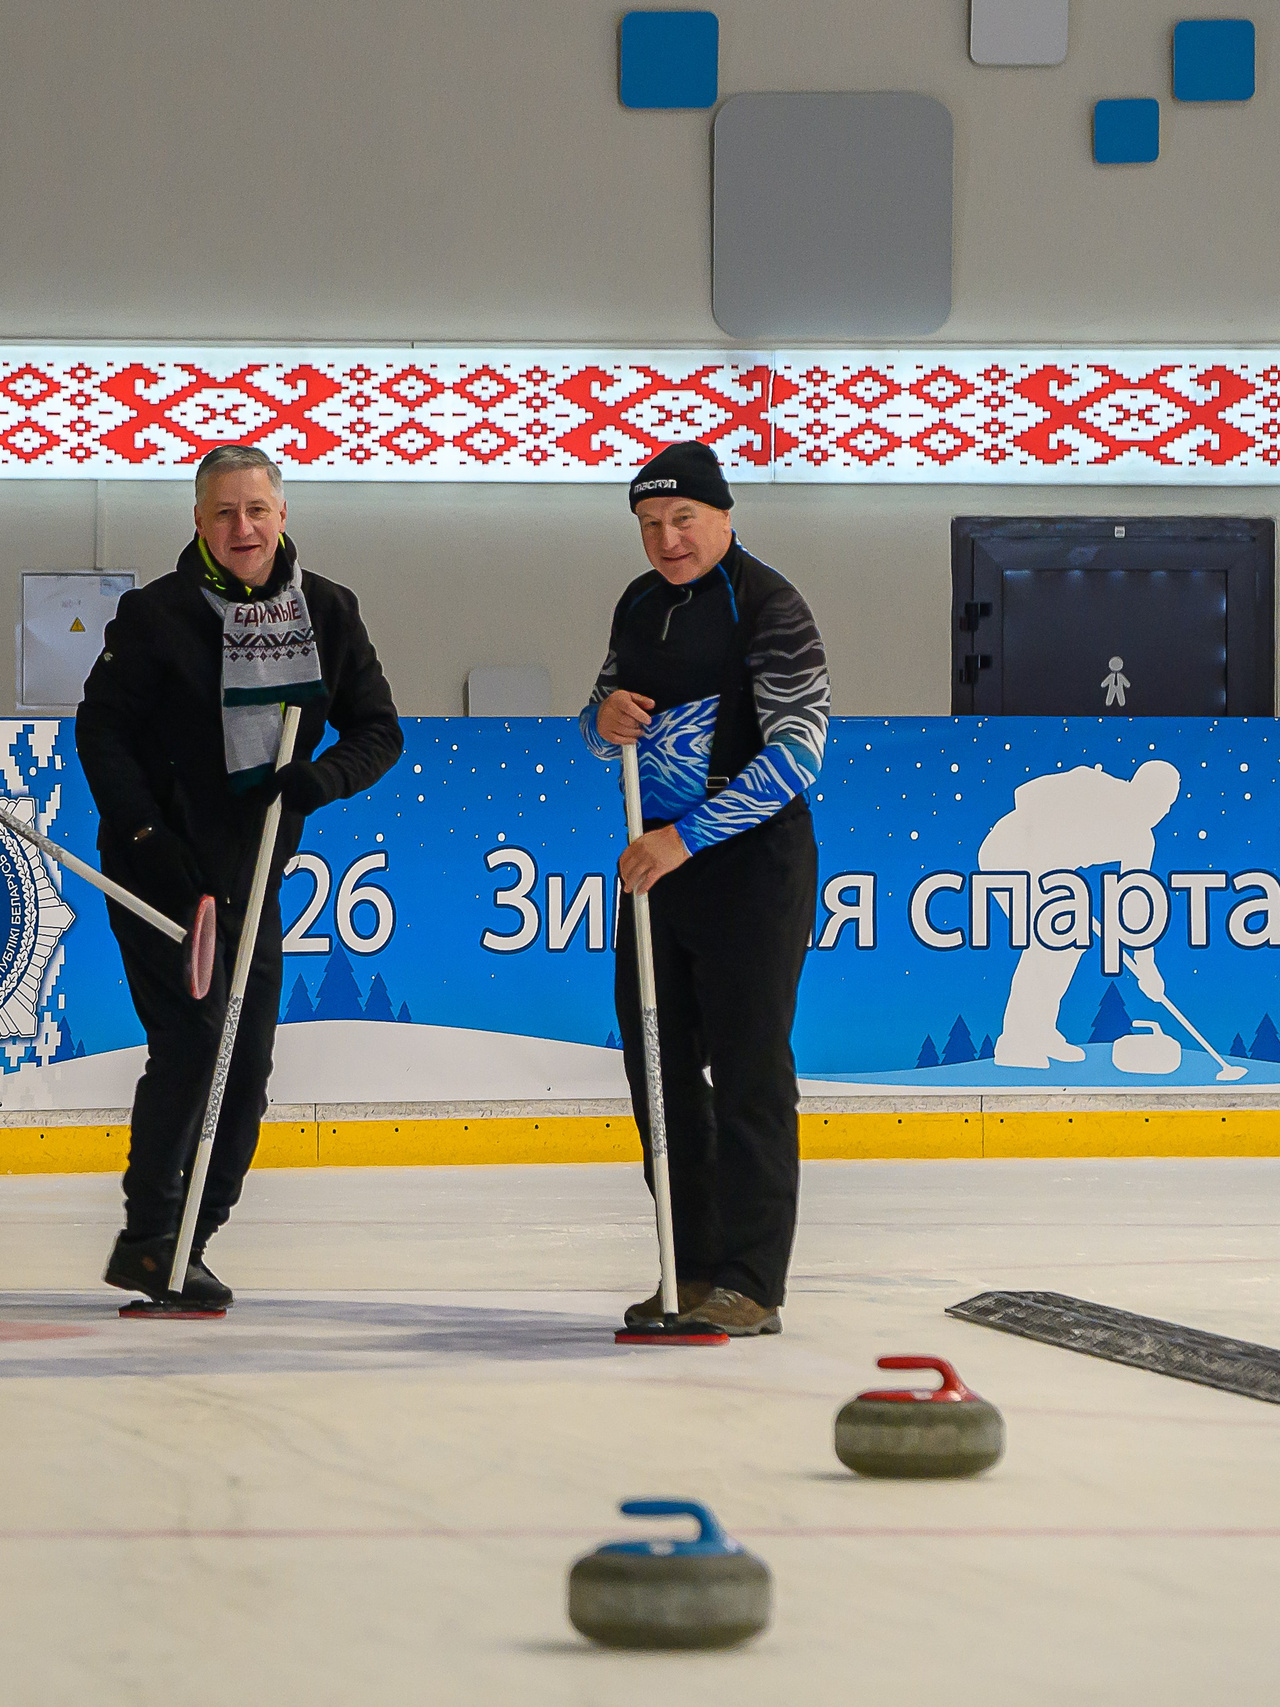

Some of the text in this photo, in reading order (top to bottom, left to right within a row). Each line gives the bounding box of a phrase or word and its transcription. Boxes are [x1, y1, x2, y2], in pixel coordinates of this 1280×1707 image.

[234, 600, 302, 628] ЕДИНЫЕ
[0, 854, 22, 925] БЕЛАРУСЬ
[909, 872, 1280, 974] спарта
